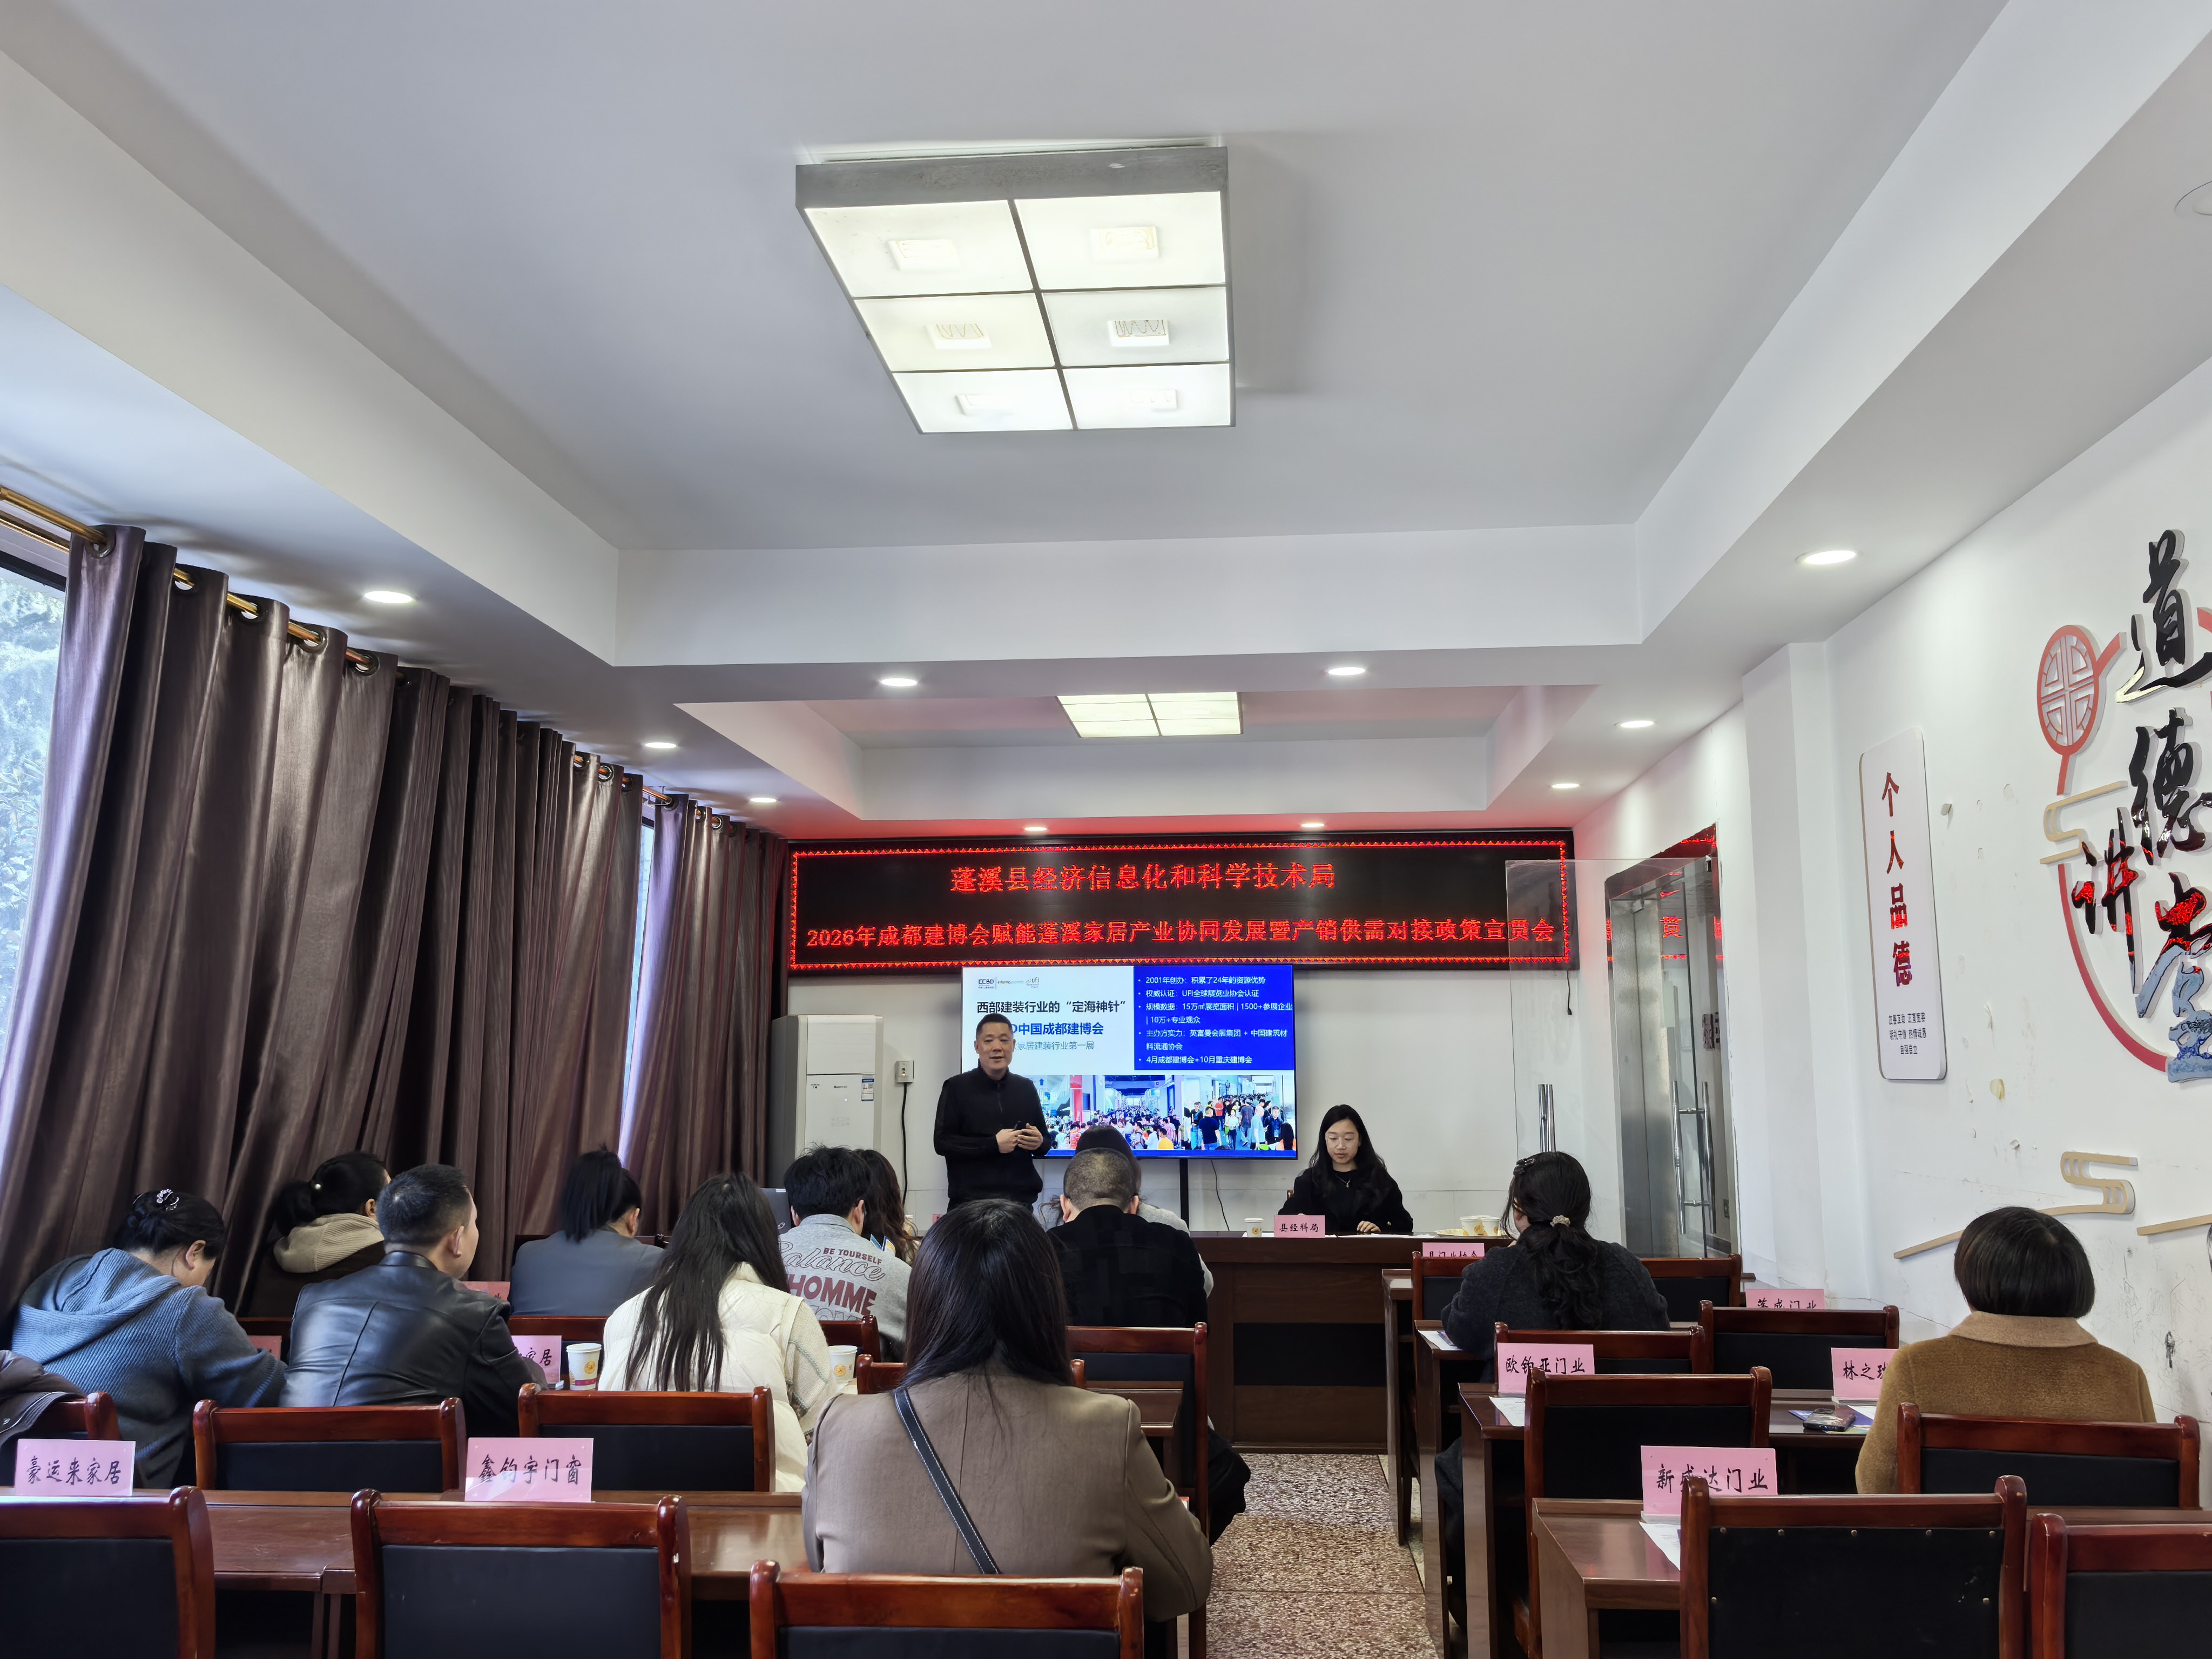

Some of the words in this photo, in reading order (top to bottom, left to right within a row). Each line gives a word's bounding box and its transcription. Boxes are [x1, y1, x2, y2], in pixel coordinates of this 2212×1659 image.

[950, 862, 1335, 892] 蓬溪县经济信息化和科学技术局
[1881, 772, 1913, 987] 个人品德
[807, 918, 1555, 947] 2026年成都建博会赋能蓬溪家居产业协同发展暨产销供需对接政策宣贯会
[976, 1000, 1126, 1014] 西部建装行业的“定海神针”
[1014, 1041, 1095, 1050] 家居建装行业第一展
[1146, 1042, 1183, 1051] 料流通协会
[1279, 1223, 1319, 1233] 县经科局
[838, 1249, 882, 1265] YOURSELF
[788, 1273, 877, 1315] HOMME
[26, 1455, 122, 1485] 豪运来家居
